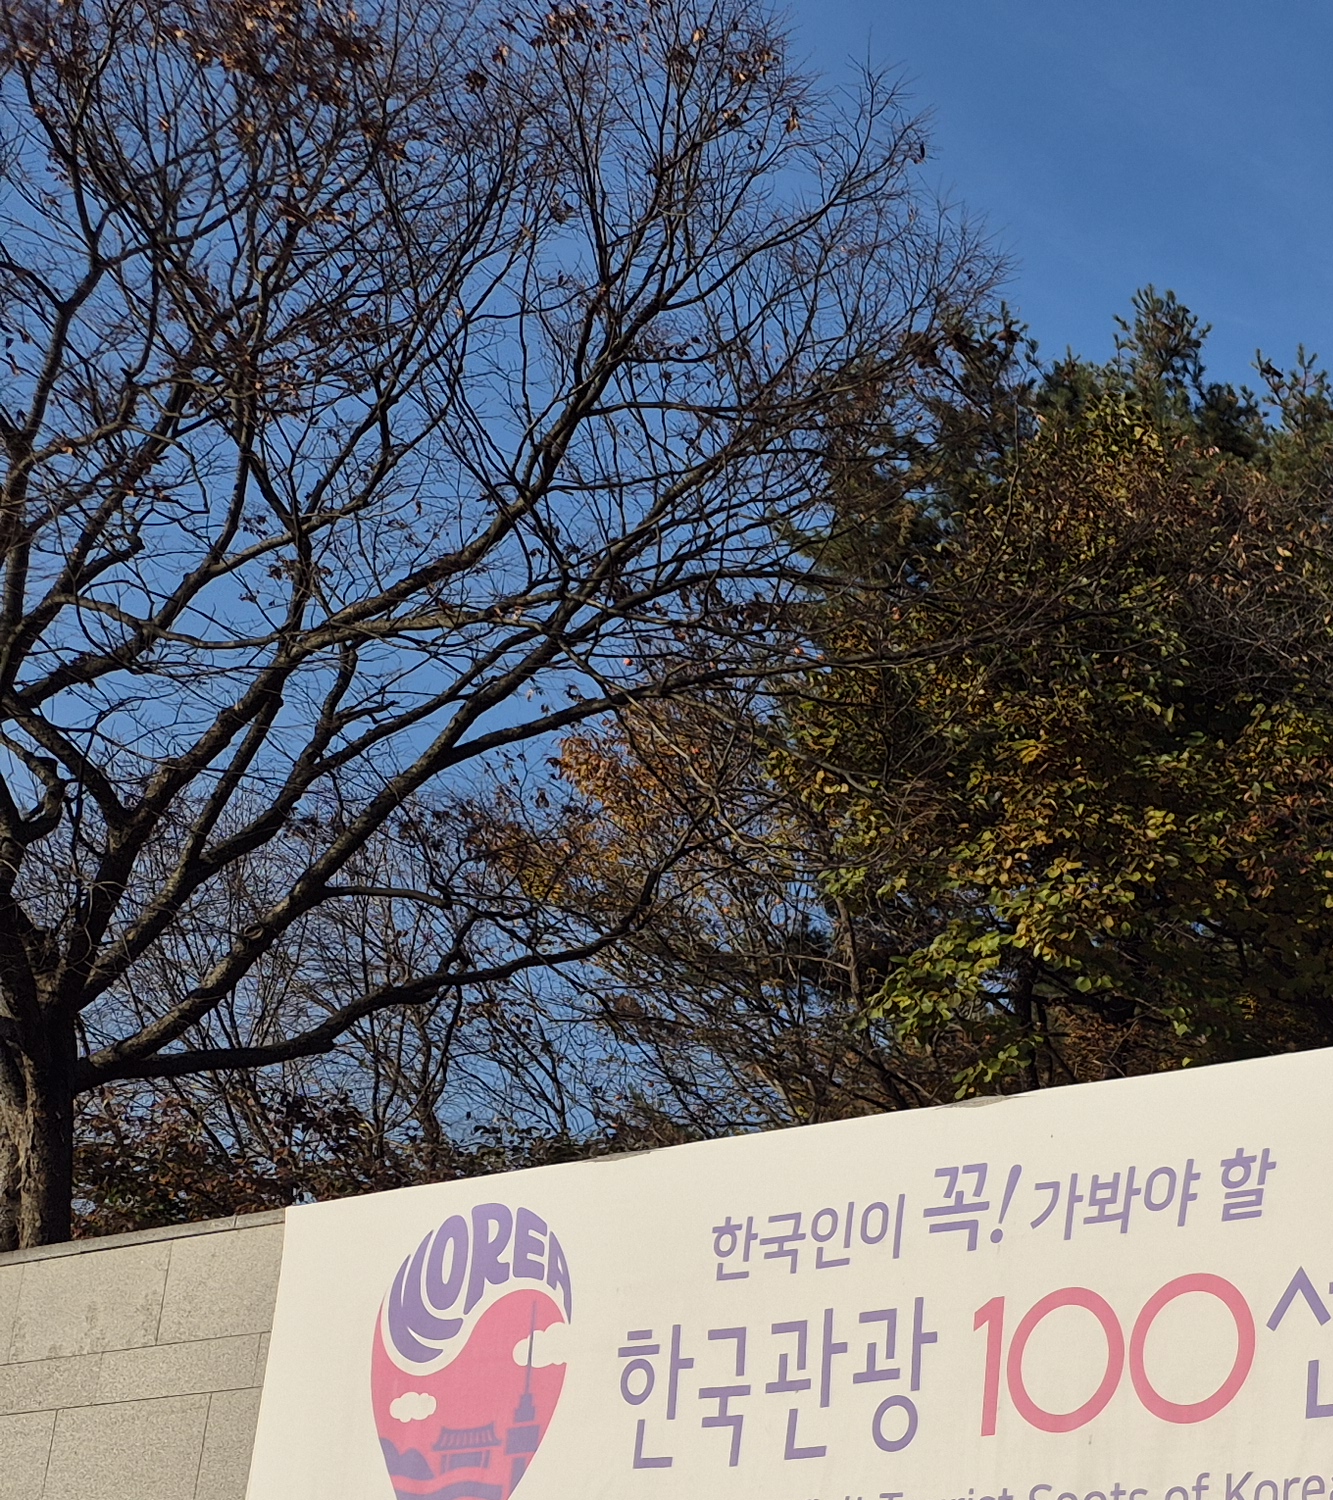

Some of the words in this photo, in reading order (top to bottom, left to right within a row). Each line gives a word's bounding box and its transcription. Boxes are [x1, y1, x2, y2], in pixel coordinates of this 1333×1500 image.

[710, 1193, 905, 1282] 한국인이
[922, 1161, 1023, 1252] 꼭!
[1028, 1157, 1201, 1242] 가봐야
[1219, 1146, 1277, 1223] 할
[616, 1296, 939, 1470] 한국관광
